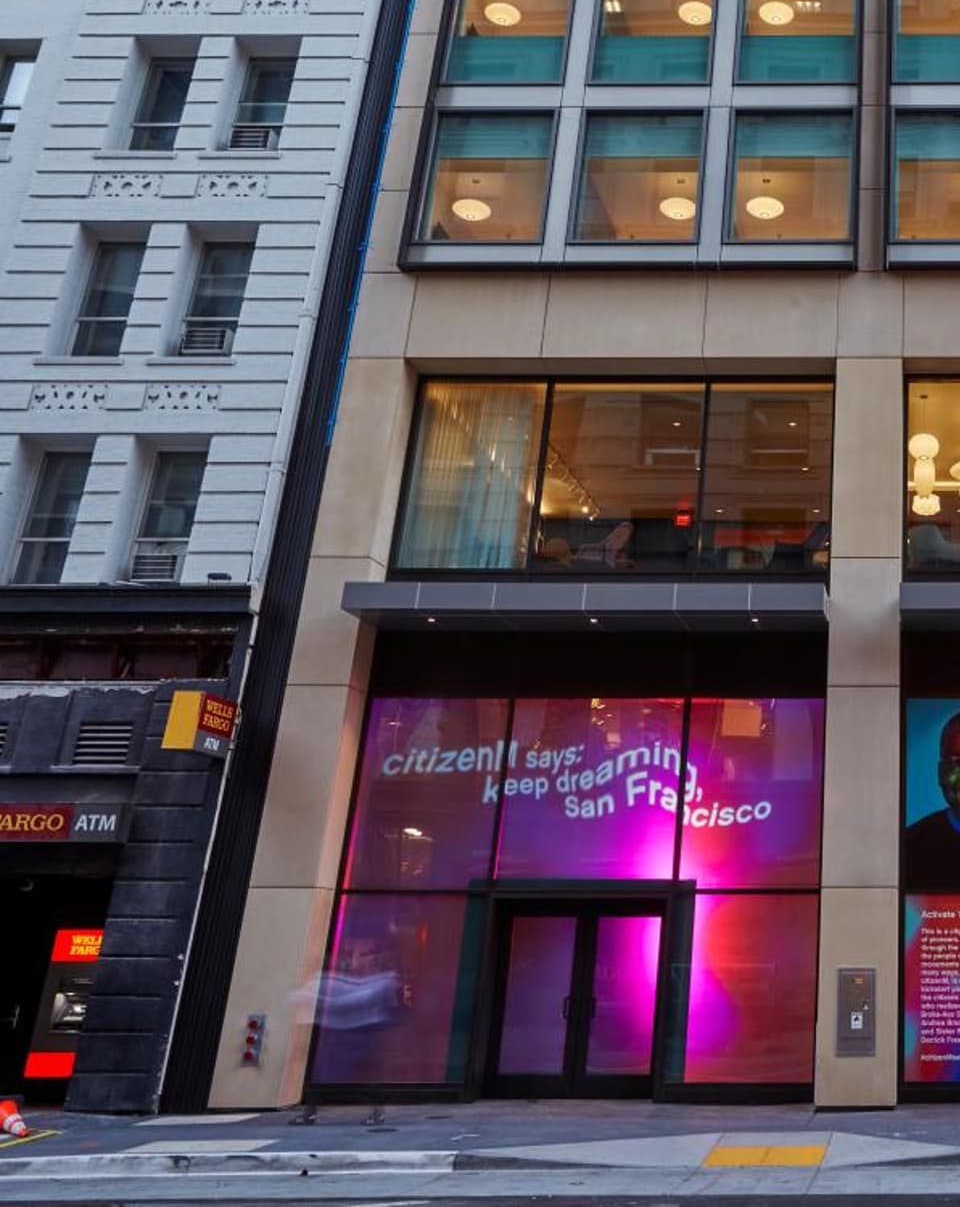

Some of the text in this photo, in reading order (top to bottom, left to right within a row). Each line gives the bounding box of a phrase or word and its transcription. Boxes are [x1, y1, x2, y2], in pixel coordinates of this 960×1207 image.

[206, 698, 234, 719] WELLS
[202, 713, 231, 732] FARGO
[203, 737, 220, 751] ATM
[525, 744, 585, 774] says:
[482, 775, 549, 803] keep
[564, 794, 616, 819] San
[0, 813, 117, 832] ARGO ATM
[920, 909, 955, 918] Activate
[71, 935, 102, 945] WEL
[69, 945, 101, 955] FARG
